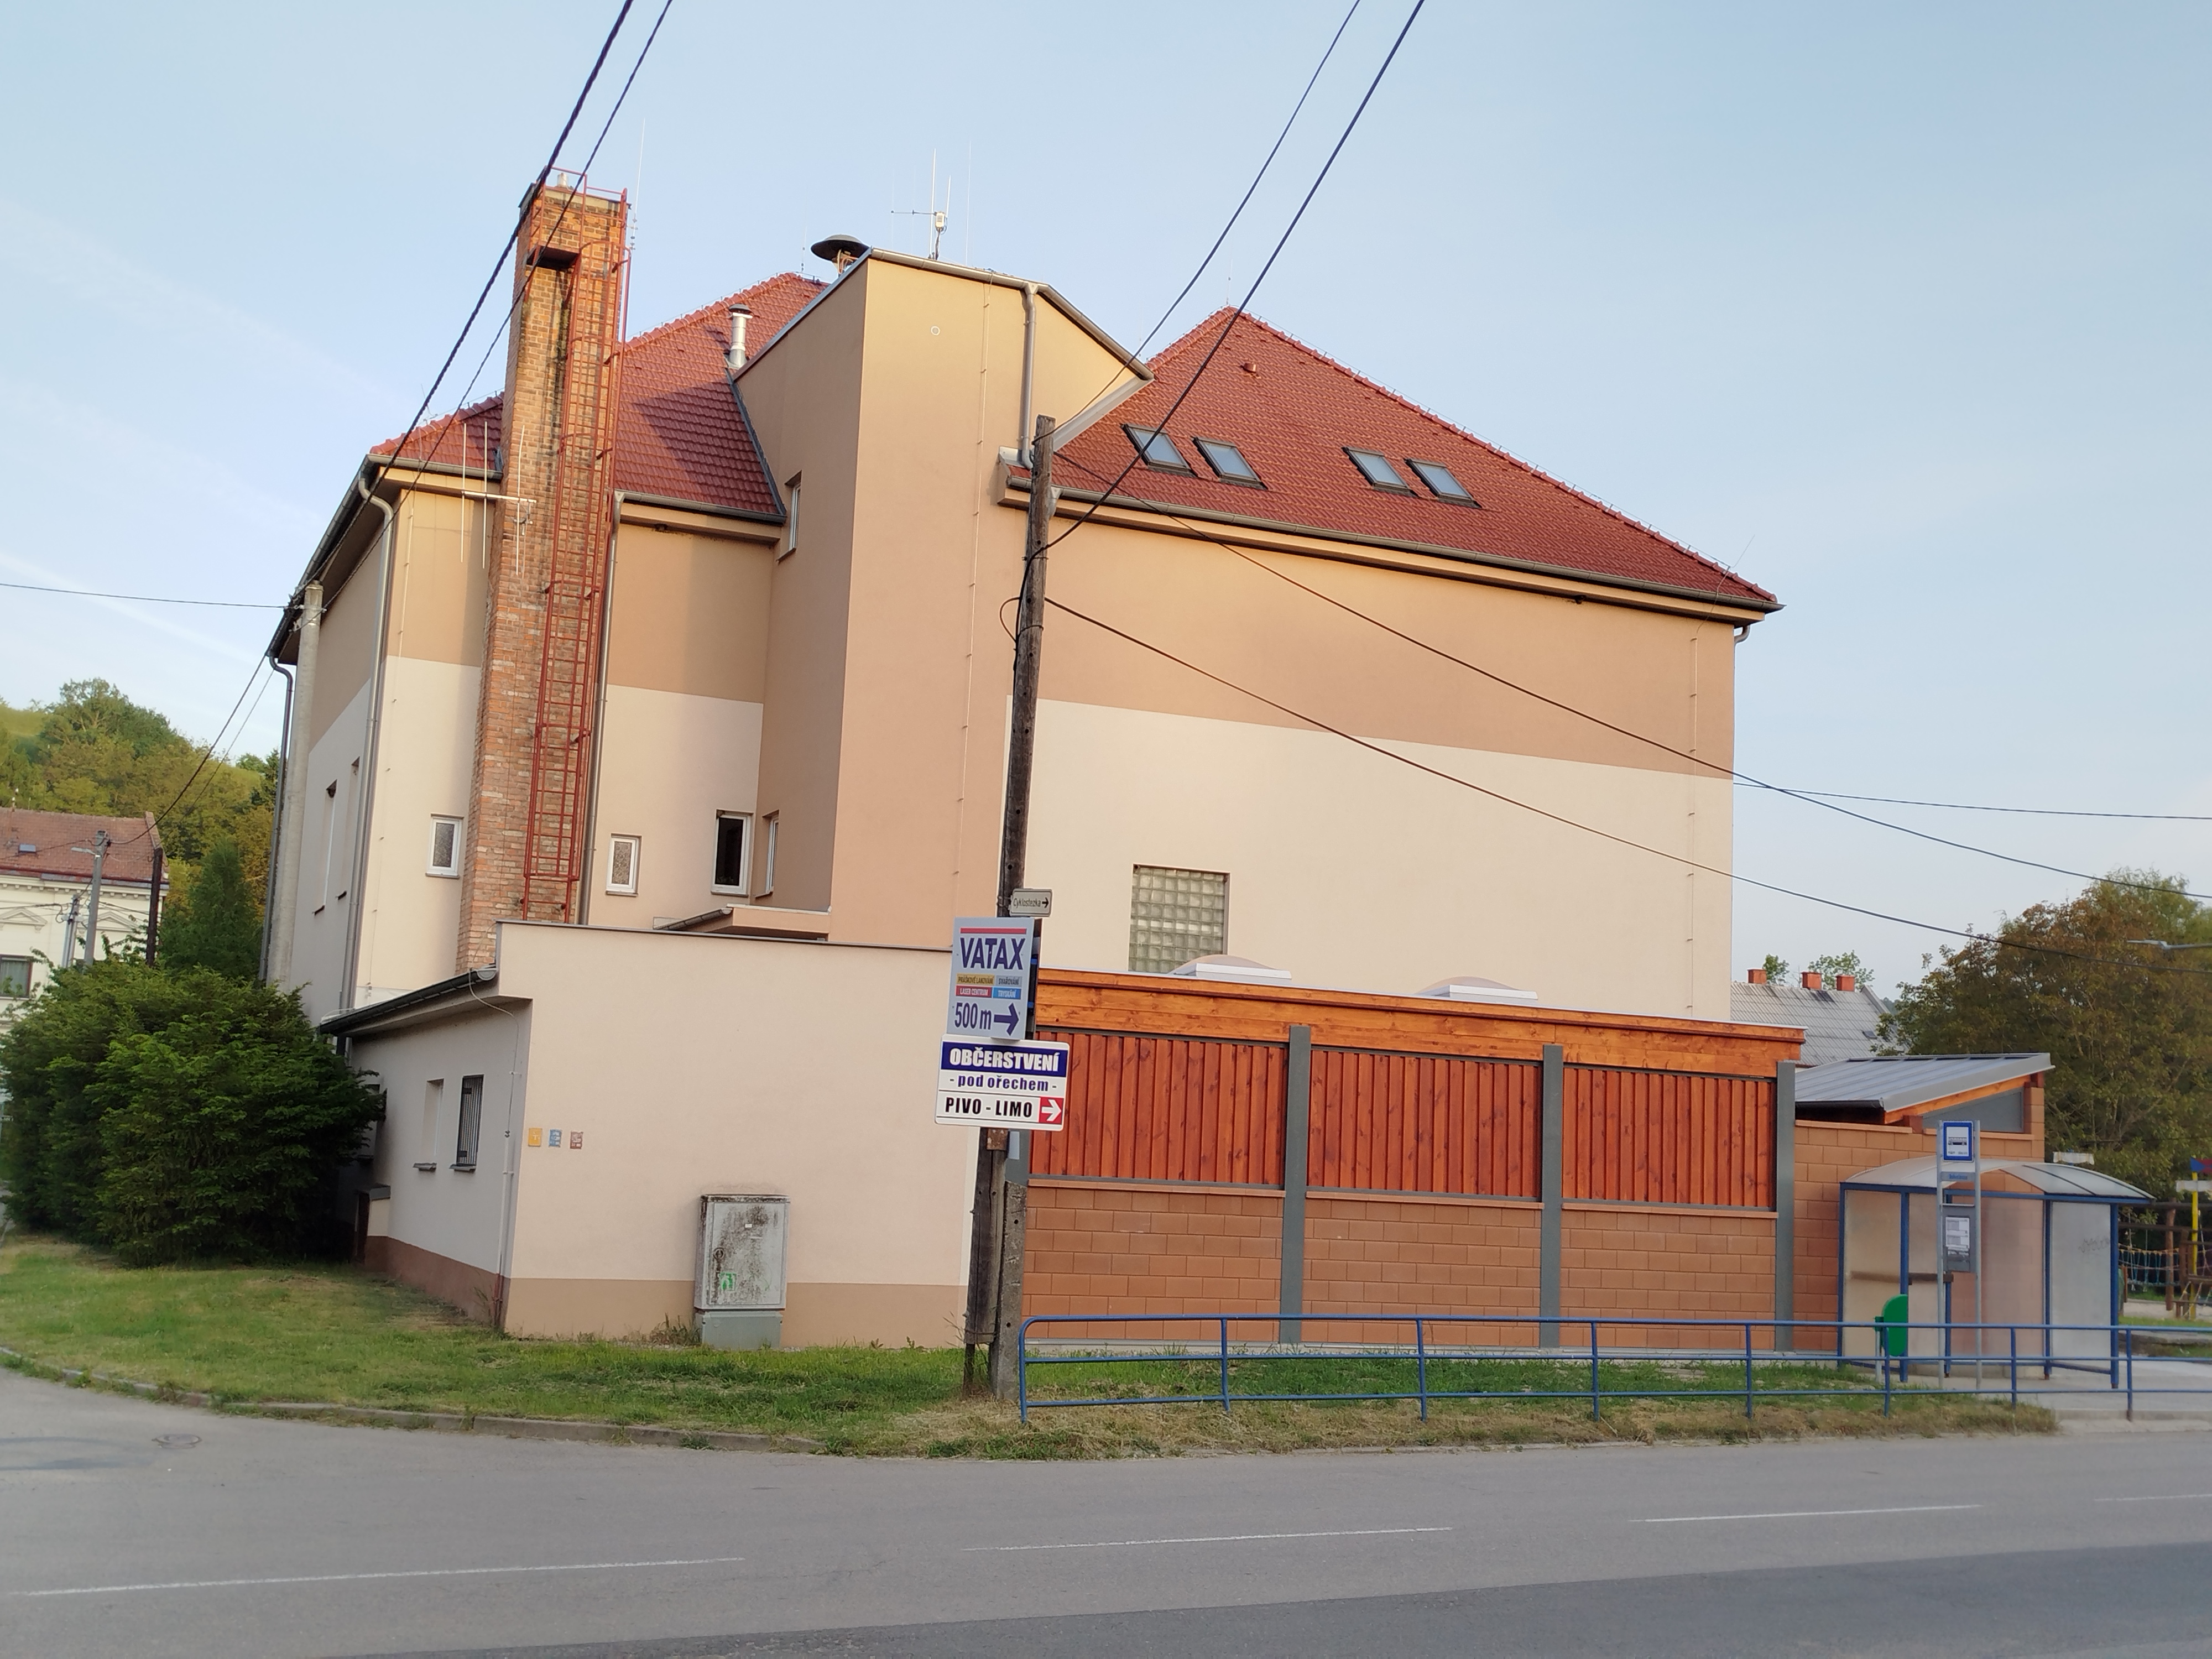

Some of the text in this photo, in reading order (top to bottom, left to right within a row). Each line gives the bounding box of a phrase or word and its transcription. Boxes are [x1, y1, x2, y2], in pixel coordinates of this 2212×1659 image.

[960, 937, 1025, 969] VATAX
[954, 1003, 992, 1030] 500 m
[950, 1046, 1060, 1072] OBČERSTVENÍ
[958, 1074, 984, 1088] pod
[987, 1074, 1048, 1092] ořechem
[945, 1097, 982, 1115] PIVO
[995, 1099, 1033, 1118] LIMO
